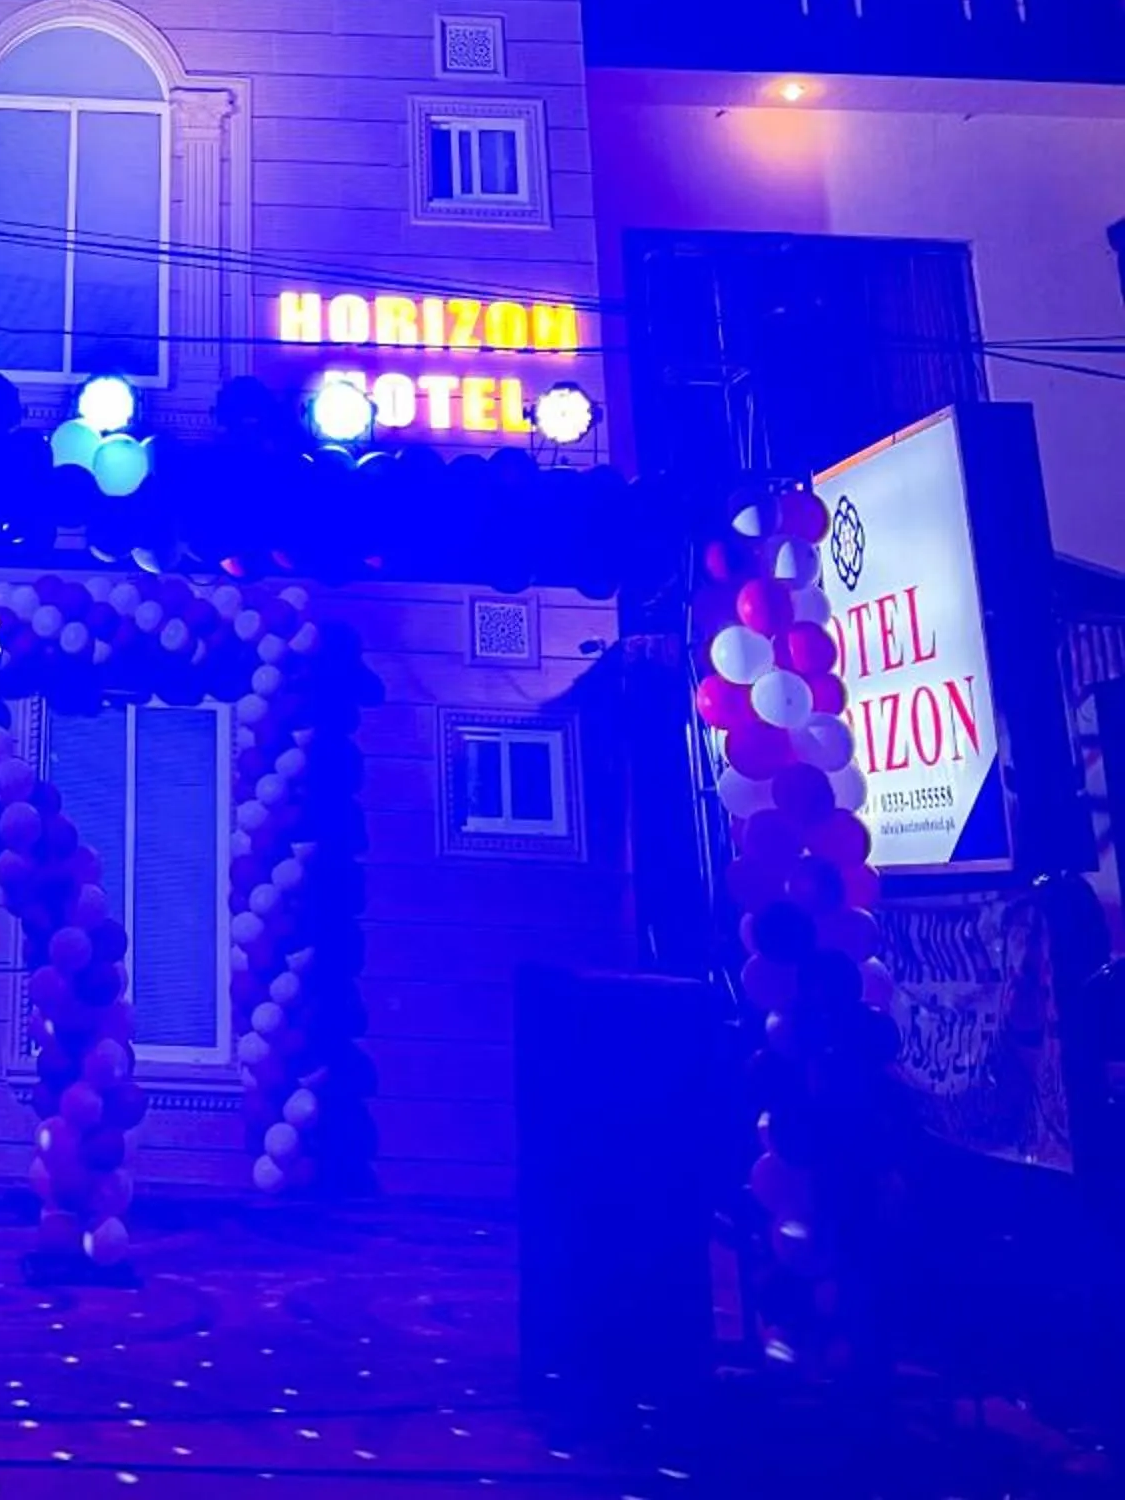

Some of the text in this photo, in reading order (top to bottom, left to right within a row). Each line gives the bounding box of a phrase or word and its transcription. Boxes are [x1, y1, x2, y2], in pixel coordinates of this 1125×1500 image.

[278, 290, 579, 352] HORIZON
[831, 584, 937, 680] TEL
[844, 675, 980, 776] IZON
